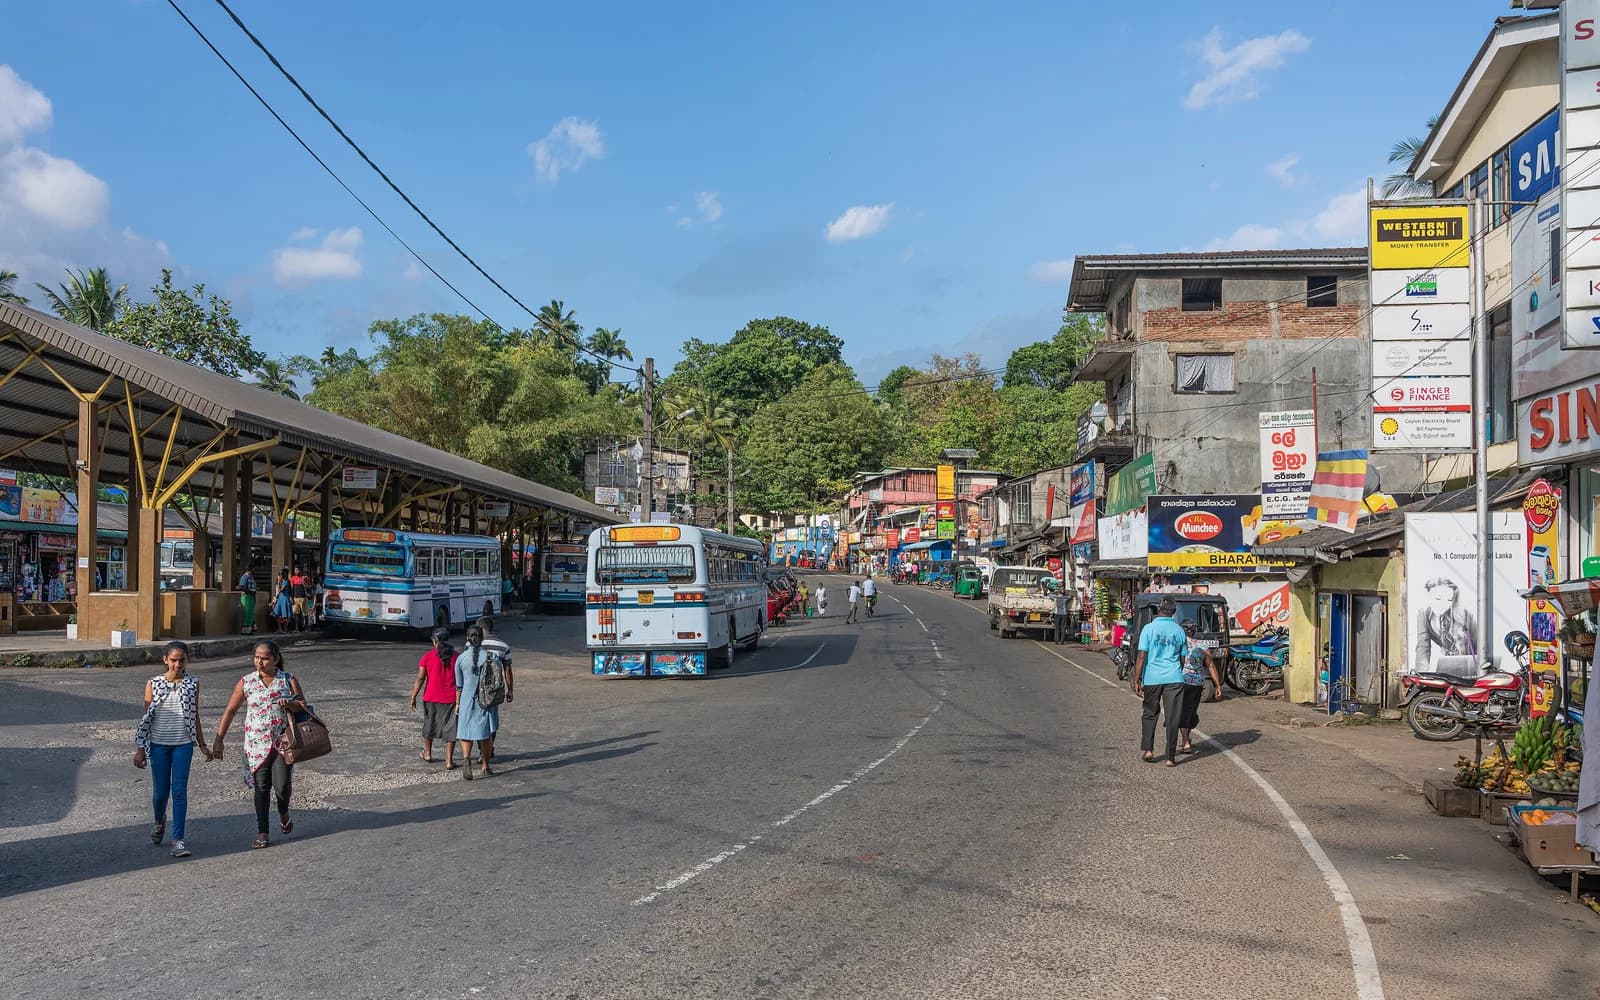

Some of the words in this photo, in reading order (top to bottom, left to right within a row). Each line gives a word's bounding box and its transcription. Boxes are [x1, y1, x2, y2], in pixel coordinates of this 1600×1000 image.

[1382, 222, 1445, 231] WESTERN
[1402, 229, 1445, 237] UNION
[1271, 428, 1296, 448] ලේ
[1181, 522, 1219, 534] Munchee
[1433, 552, 1443, 560] No.
[1449, 552, 1477, 561] Computer
[1495, 551, 1513, 559] Lanka
[1251, 591, 1282, 624] EGB
